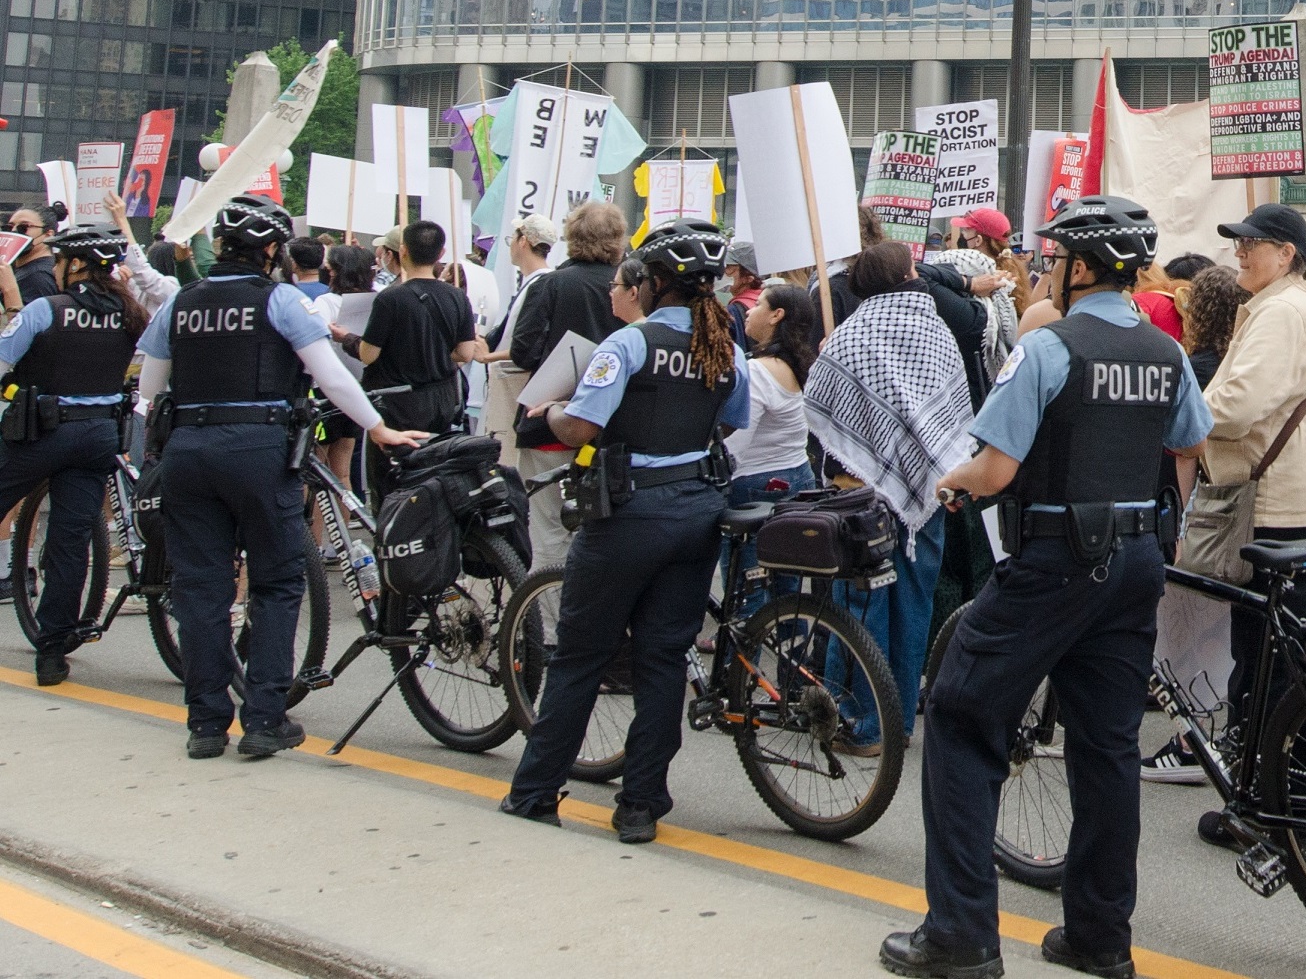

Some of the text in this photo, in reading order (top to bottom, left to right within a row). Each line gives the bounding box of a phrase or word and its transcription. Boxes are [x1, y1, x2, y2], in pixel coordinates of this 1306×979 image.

[1211, 25, 1292, 53] STOP THE
[1211, 48, 1294, 66] TRUMP AGENDA!
[1209, 61, 1298, 77] DEFEND & EXPAND
[1209, 71, 1299, 86] IMMIGRANT RIGHTS
[1211, 82, 1298, 95] STAND WITH PALESTINE
[1211, 95, 1221, 103] END
[1223, 94, 1232, 103] US
[1250, 92, 1261, 100] TO
[1266, 90, 1298, 99] ISRAEL
[1211, 100, 1299, 115] STOP POLICE CRIMES
[936, 109, 979, 125] STOP
[1211, 112, 1300, 126] DEFEND LGBTQIA+ AND
[1211, 122, 1300, 136] REPRODUCTIVE RIGHTS
[902, 134, 937, 155] THE
[941, 138, 996, 152] ORTATION
[1212, 132, 1301, 145] DEFEND RIGHTS TO
[1213, 141, 1302, 154] UNIONIZE & STRIKE
[888, 152, 935, 167] AGENDA!
[1063, 153, 1081, 166] STOP
[1213, 152, 1301, 165] DEFEND EDUCATION &
[896, 164, 936, 176] EXPAND
[938, 165, 976, 179] KEEP
[1061, 165, 1083, 176] DEPORT
[1213, 161, 1303, 174] ACADEMIC FREEDOM
[88, 176, 116, 188] HERE
[900, 172, 936, 184] RIGHTS
[601, 184, 613, 196] HE
[890, 182, 932, 192] PALESTINE
[934, 177, 990, 194] AMILIES
[902, 189, 931, 198] ISRAEL
[932, 191, 995, 209] OGETHER
[898, 199, 931, 208] CRIMES
[912, 210, 930, 218] AND
[1075, 207, 1107, 216] POLICE
[898, 217, 928, 226] RIGHTS
[892, 224, 915, 233] RIGHTS
[892, 232, 925, 241] STRIKE
[63, 307, 123, 330] POLIC
[176, 307, 256, 335] POLICE
[652, 347, 730, 384] POL
[1092, 363, 1173, 403] POLICE
[315, 490, 361, 601] CHICAGO POLICE
[378, 539, 425, 560] LICE
